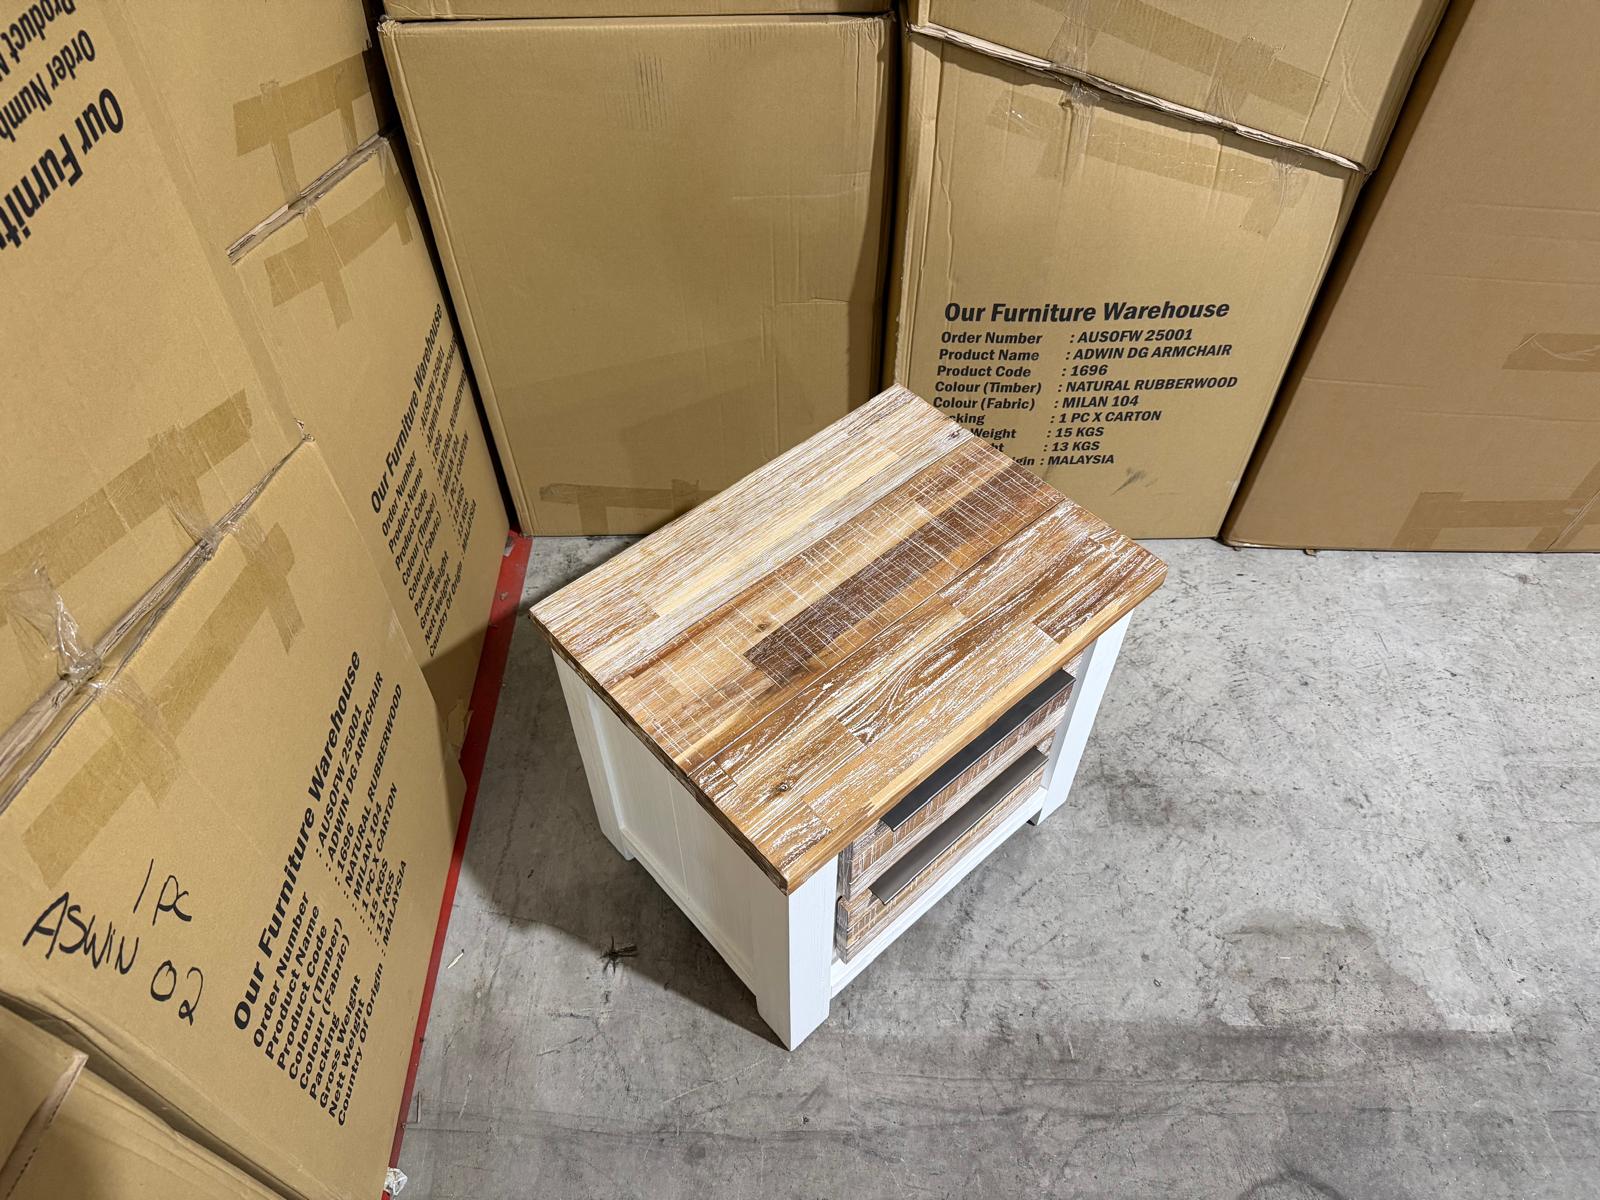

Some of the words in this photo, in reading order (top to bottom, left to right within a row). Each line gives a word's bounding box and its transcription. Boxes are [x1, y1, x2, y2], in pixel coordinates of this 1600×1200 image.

[46, 29, 95, 90] Order
[0, 72, 53, 143] Numb
[74, 88, 124, 155] Our
[0, 133, 84, 249] Furnit
[941, 331, 982, 343] Order
[985, 332, 1043, 344] Number
[1077, 330, 1144, 343] AUSOFW
[1144, 329, 1192, 341] 25001
[945, 303, 986, 322] Our
[991, 303, 1096, 322] Furniture
[1104, 301, 1230, 321] Warehouse
[935, 381, 981, 392] Colour
[983, 382, 1041, 395] (Timber)
[1066, 380, 1130, 392] NATURAL
[1134, 377, 1238, 390] RUBBERWOOD
[937, 365, 992, 377] Product
[995, 366, 1031, 377] Code
[1070, 364, 1108, 376] 1696
[939, 349, 995, 360] Product
[998, 349, 1039, 361] Name
[1073, 347, 1125, 360] ADWIN
[1127, 347, 1149, 358] DG
[1151, 344, 1232, 358] ARMCHAIR
[371, 472, 389, 513] Our
[386, 390, 418, 477] Furniture
[414, 303, 442, 393] Warehouse
[933, 397, 978, 409] Colour
[980, 397, 1035, 411] (Fabric)
[1062, 396, 1108, 408] MILAN
[1112, 395, 1139, 407] 104
[1055, 428, 1074, 438] 15
[1076, 427, 1104, 438] KGS
[1059, 413, 1066, 422] 1
[1071, 412, 1091, 422] PC
[1092, 412, 1102, 422] X
[1105, 410, 1161, 422] CARTON
[1047, 454, 1115, 466] MALAYSIA
[1051, 442, 1070, 452] 13
[1072, 441, 1100, 452] KGS
[382, 498, 398, 536] Order
[395, 450, 416, 501] Number
[388, 501, 410, 554] Product
[407, 468, 423, 505] Name
[395, 518, 416, 571] Product
[414, 489, 428, 521] Code
[402, 542, 419, 586] Colour
[417, 492, 437, 552] (Timber)
[408, 557, 425, 601] Colour
[423, 503, 441, 562] (Fabric)
[414, 558, 435, 626] Packing
[420, 594, 434, 638] Gross
[432, 551, 449, 602] Weight
[425, 614, 436, 648] Nett
[434, 564, 451, 623] Weight
[430, 598, 447, 657] Country
[234, 961, 264, 1030] Our
[258, 808, 314, 959] Furniture
[308, 651, 360, 802] Warehouse
[376, 782, 397, 853] CARTON
[253, 980, 280, 1047] Order
[276, 891, 308, 979] Number
[318, 761, 345, 848] AUSOFW
[342, 704, 362, 765] 25001
[265, 969, 300, 1060] Product
[295, 906, 319, 967] Name
[328, 793, 349, 863] ADWIN
[346, 764, 358, 794] DG
[355, 672, 383, 766] ARMCHAIR
[289, 1006, 315, 1079] Colour
[312, 918, 342, 1004] (Timber)
[345, 806, 371, 888] NATURAL
[367, 684, 401, 803] RUBBERWOOD
[365, 868, 375, 897] PC
[372, 853, 380, 870] X
[362, 899, 369, 912] 1
[277, 981, 310, 1070] Product
[307, 925, 327, 978] Code
[337, 822, 354, 874] 1696
[300, 1017, 324, 1090] Colour
[322, 934, 349, 1015] (Fabric)
[353, 838, 372, 901] MILAN
[370, 802, 382, 838] 104
[320, 1049, 341, 1108] Gross
[336, 975, 360, 1043] Weight
[370, 898, 378, 924] 15
[375, 858, 388, 897] KGS
[328, 1072, 346, 1118] Nett
[341, 999, 365, 1067] Weight
[377, 910, 385, 935] 13
[382, 870, 394, 908] KGS
[338, 1046, 362, 1126] Country
[360, 1018, 368, 1043] Of
[366, 963, 383, 1017] Origin
[383, 861, 406, 946] MALAYSIA
[309, 1012, 340, 1100] Packing
